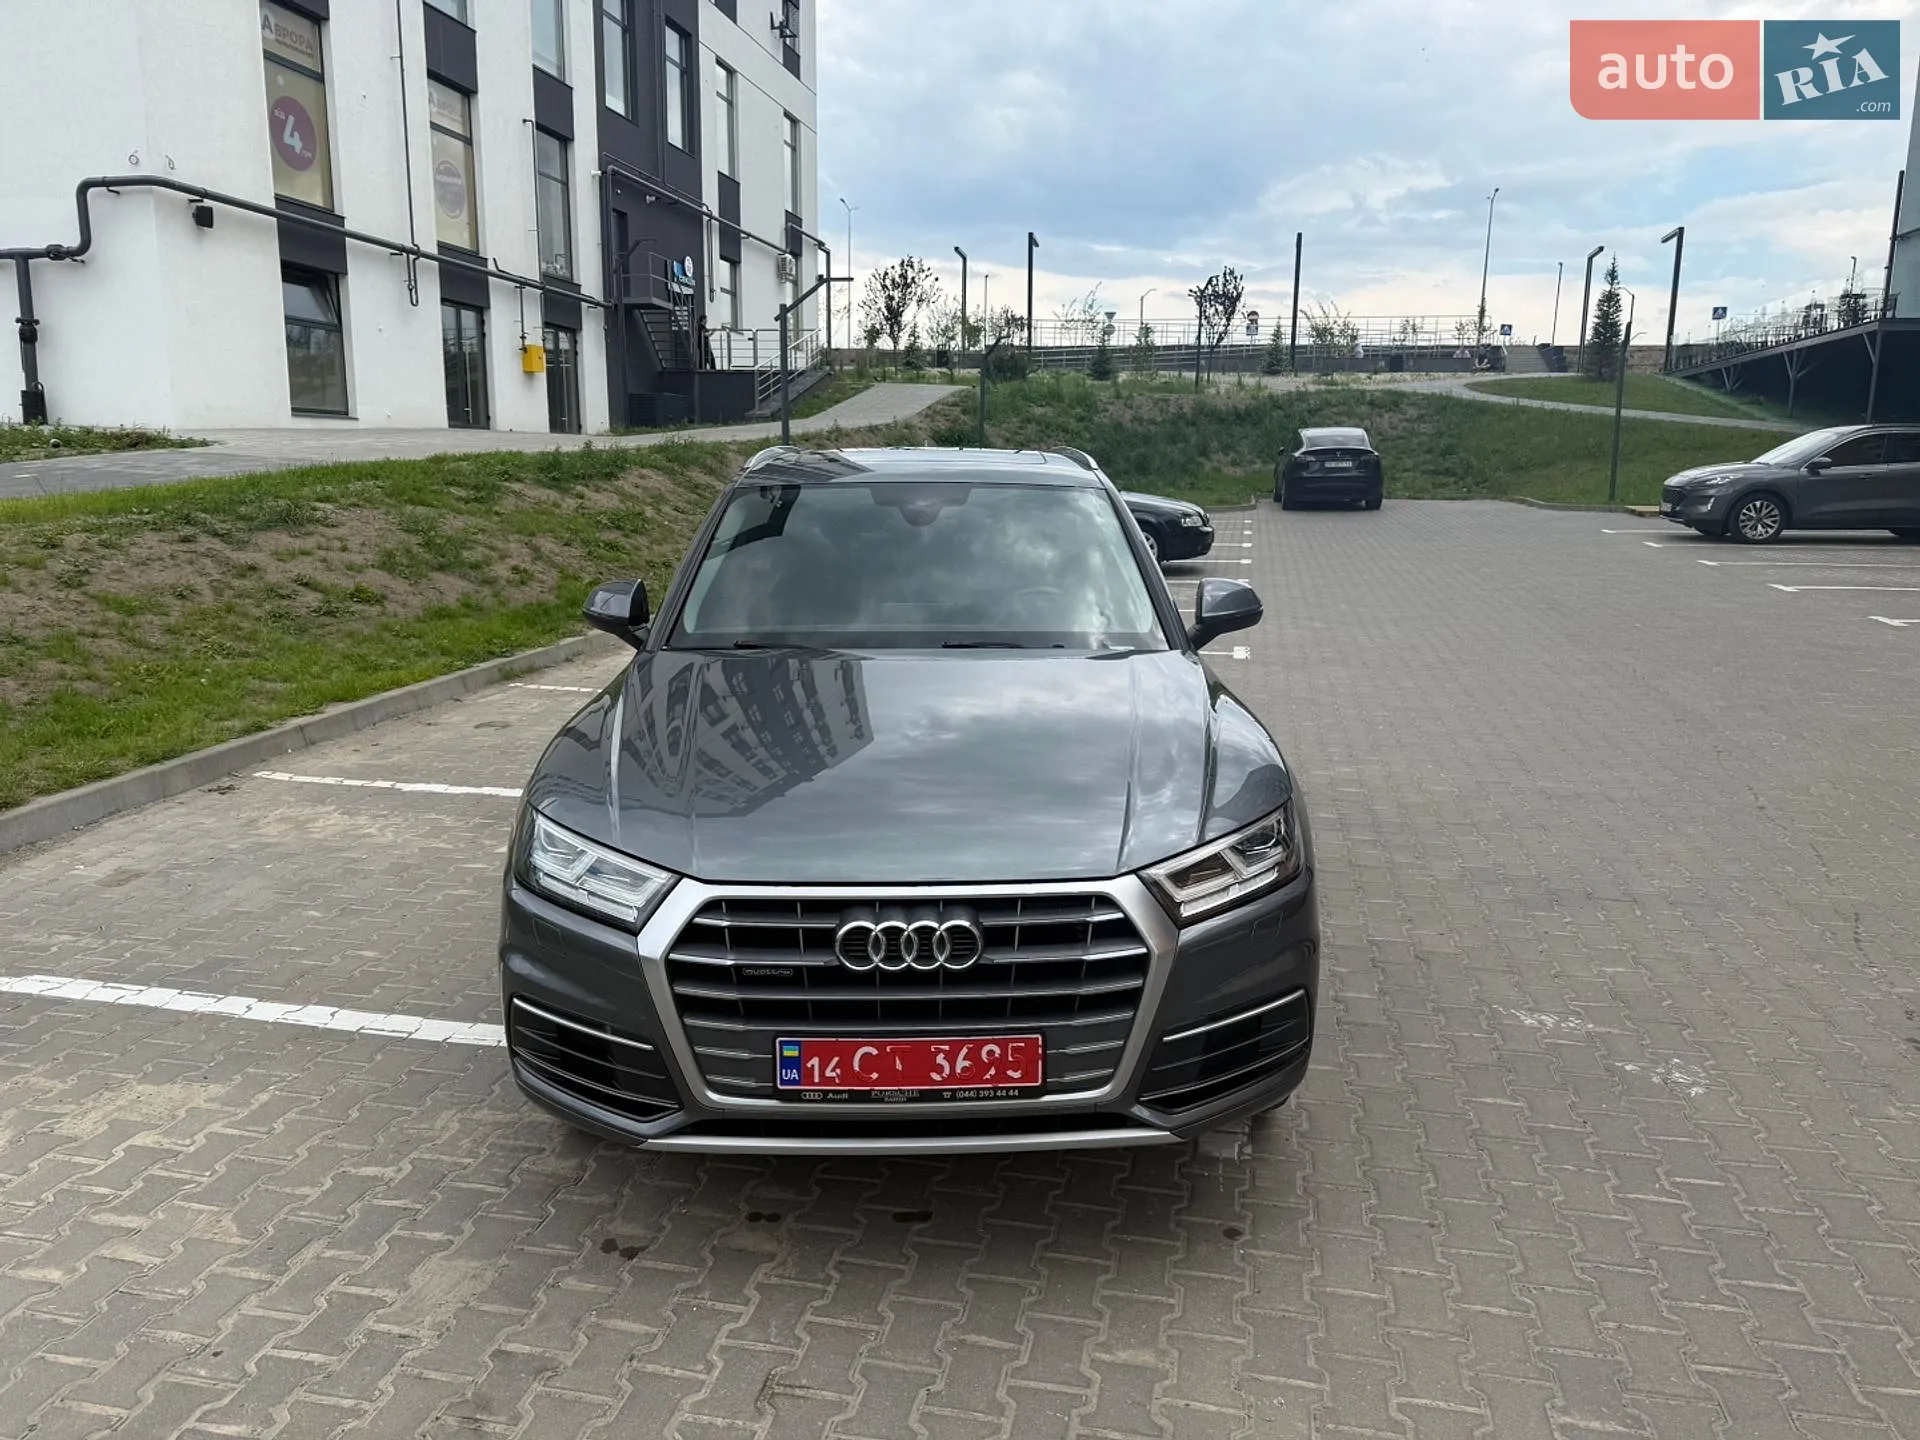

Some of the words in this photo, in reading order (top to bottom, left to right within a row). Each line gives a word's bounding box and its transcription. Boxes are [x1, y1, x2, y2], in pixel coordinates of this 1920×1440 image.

[262, 14, 313, 51] АВРОРА
[283, 114, 303, 154] 4
[782, 1069, 799, 1080] UA
[956, 1090, 977, 1098] (044)
[996, 1089, 1006, 1097] 44
